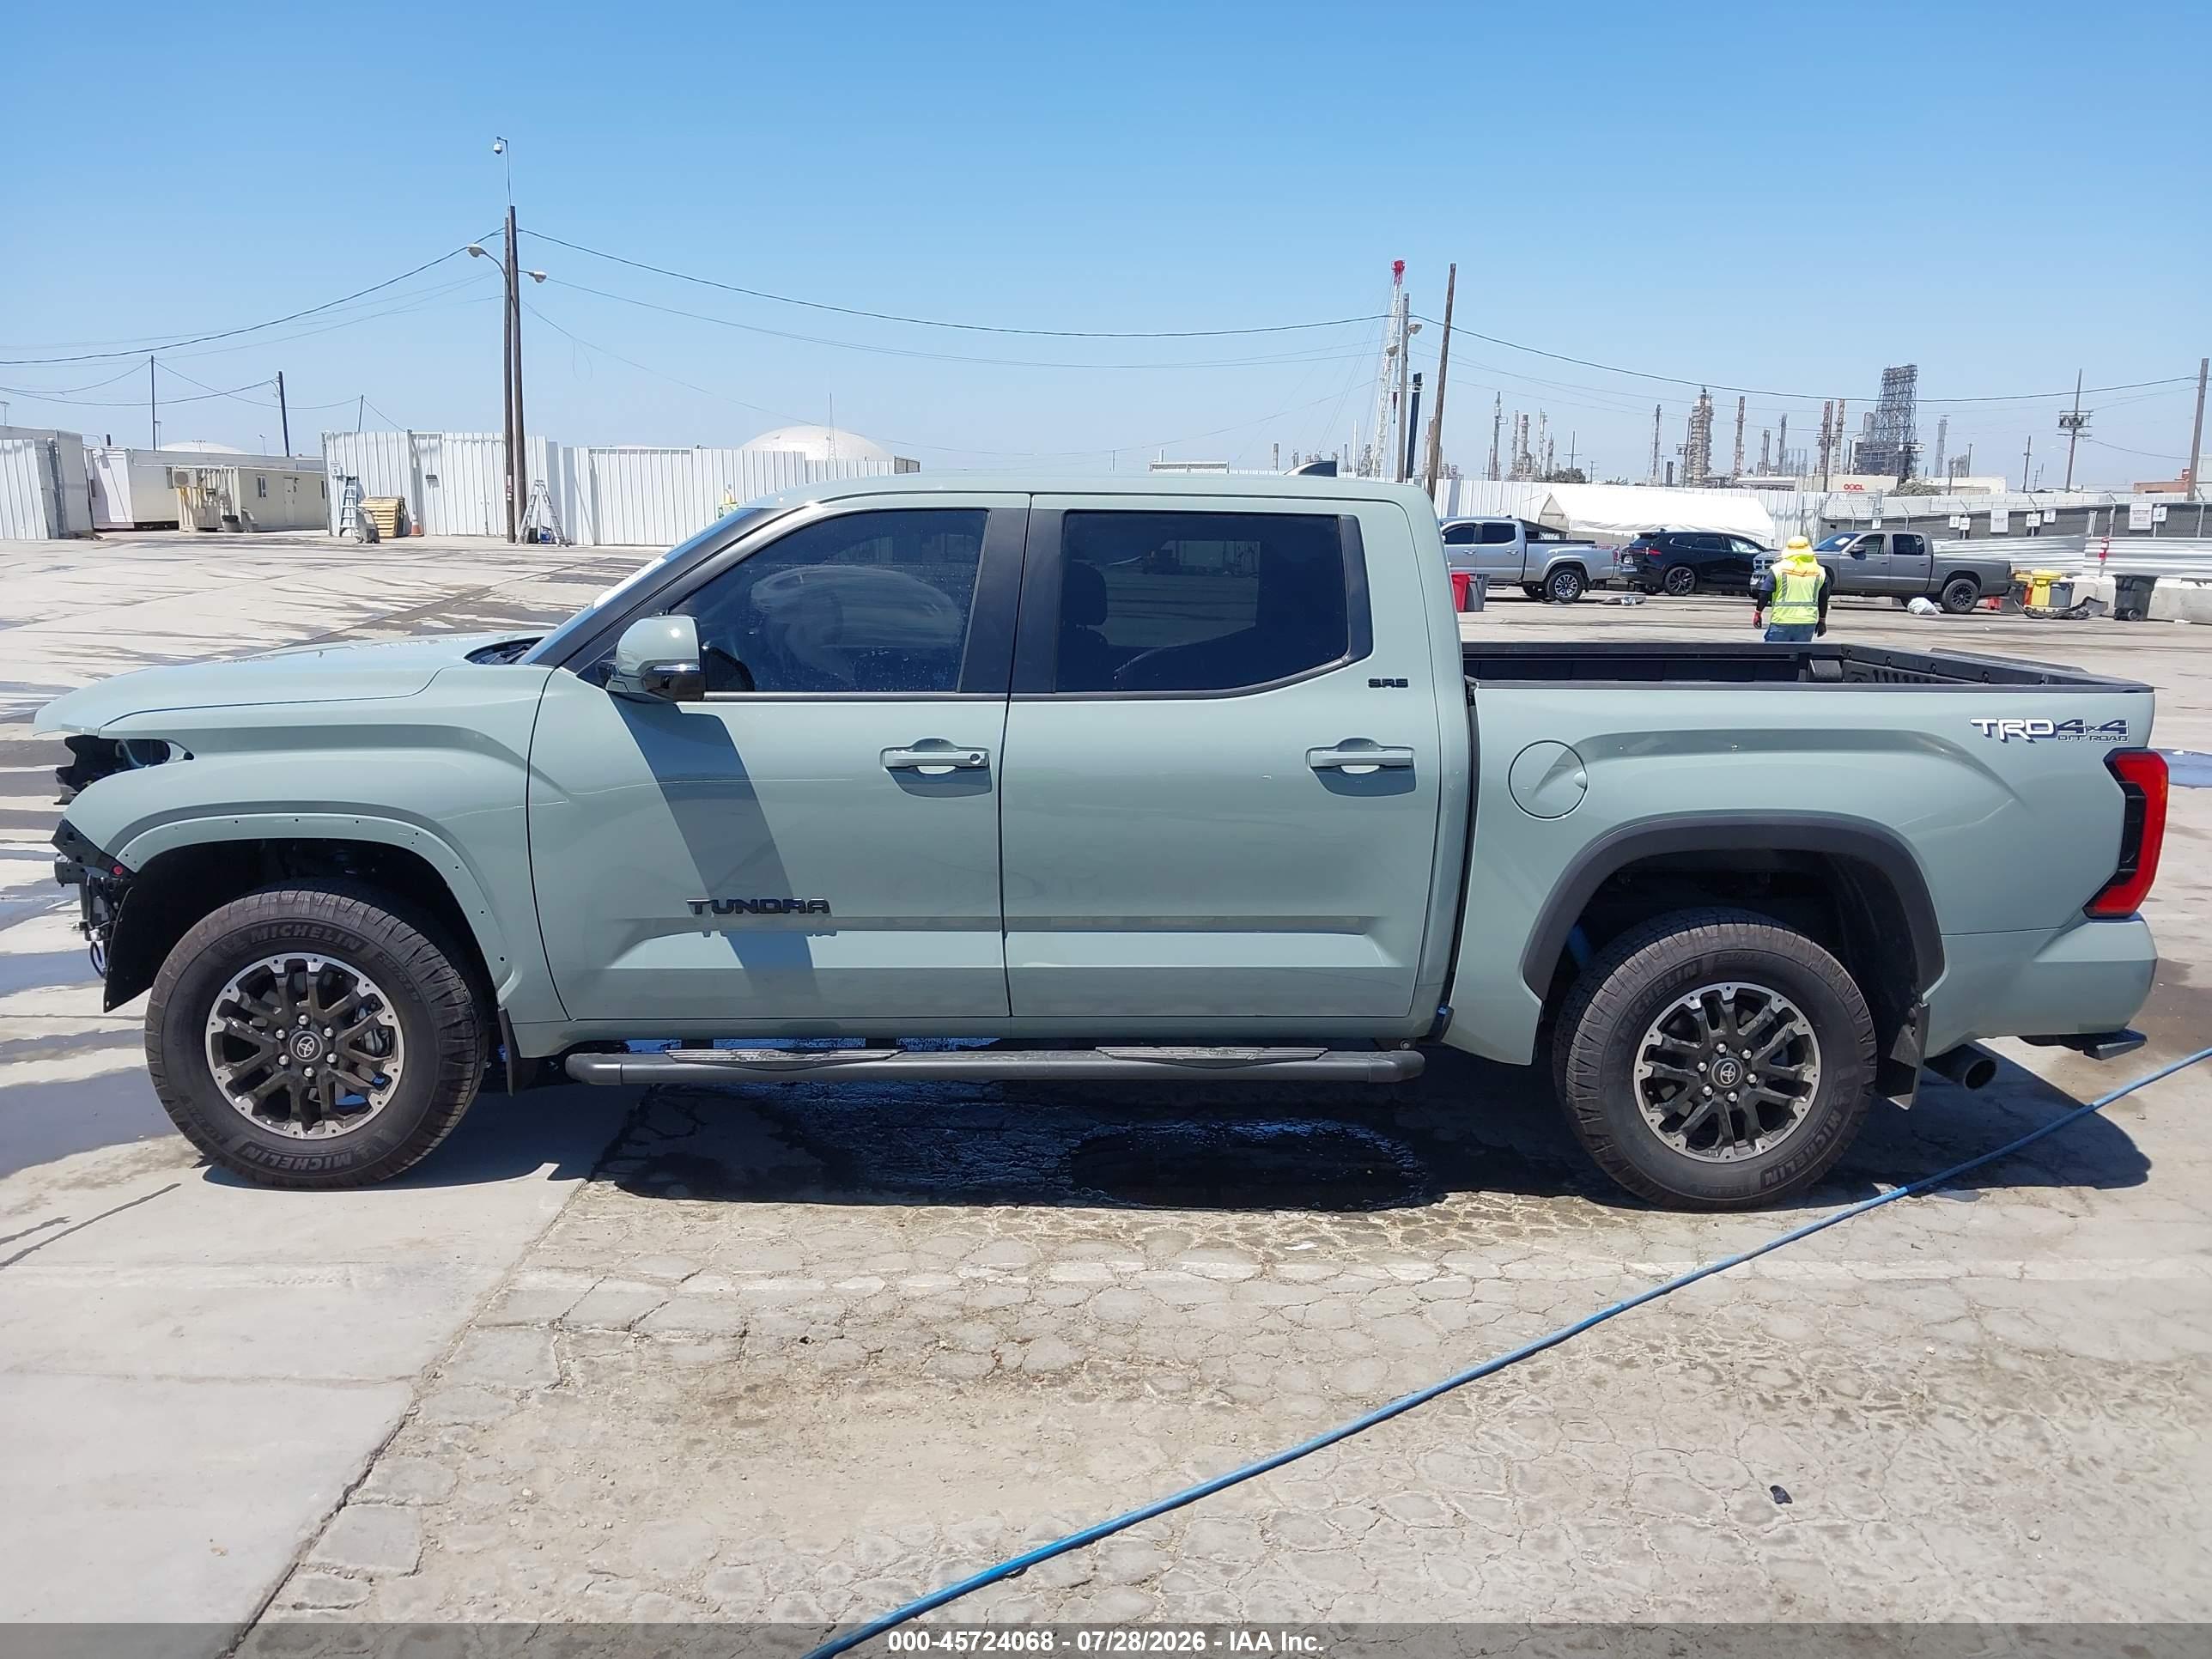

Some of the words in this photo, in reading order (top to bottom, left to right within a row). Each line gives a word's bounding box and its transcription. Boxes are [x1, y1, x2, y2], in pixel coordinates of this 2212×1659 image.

[1368, 678, 1408, 688] SR5
[1970, 718, 2057, 744] TRD
[687, 899, 830, 915] TUNDRA
[250, 923, 364, 951] MICHELIN
[240, 1145, 352, 1170] MICHELIN
[1764, 1109, 1844, 1184] MICHELIN
